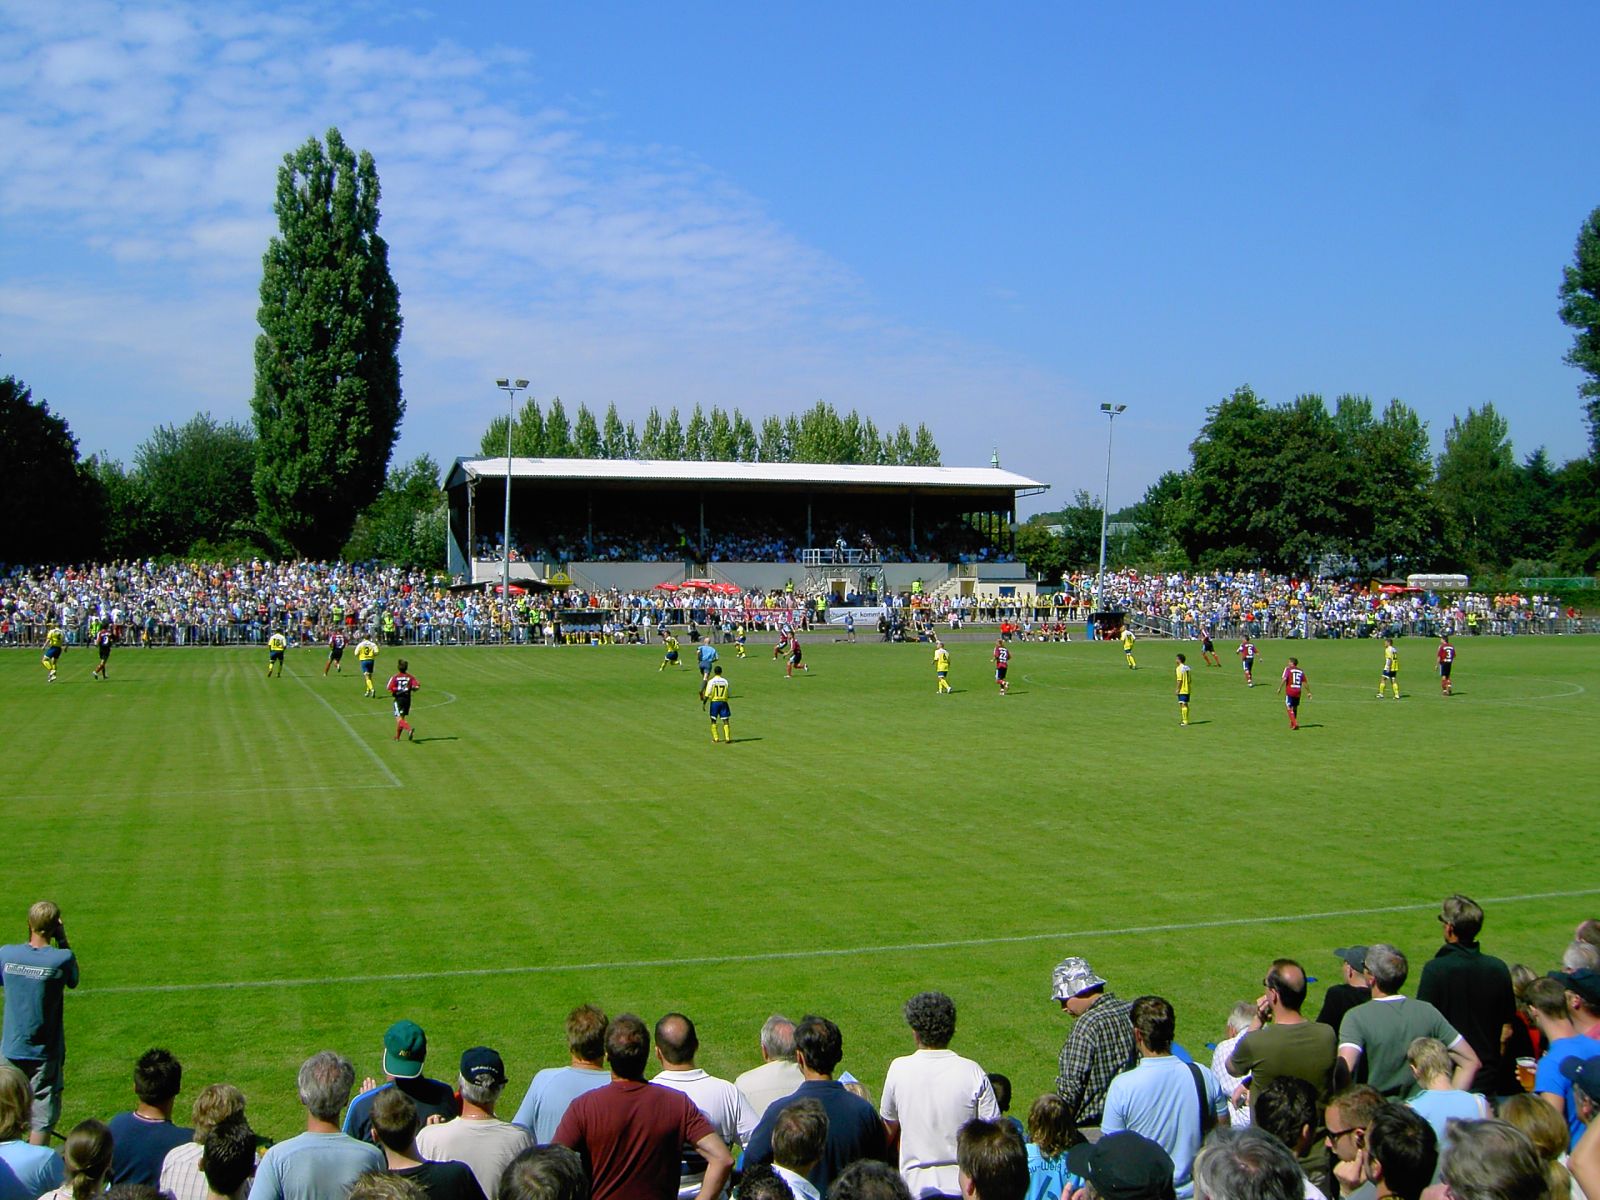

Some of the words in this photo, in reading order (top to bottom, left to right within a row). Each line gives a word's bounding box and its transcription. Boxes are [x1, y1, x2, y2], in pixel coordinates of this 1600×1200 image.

[1247, 646, 1253, 655] 6
[1446, 649, 1452, 659] 3
[1292, 672, 1302, 684] 15
[714, 685, 726, 697] 17
